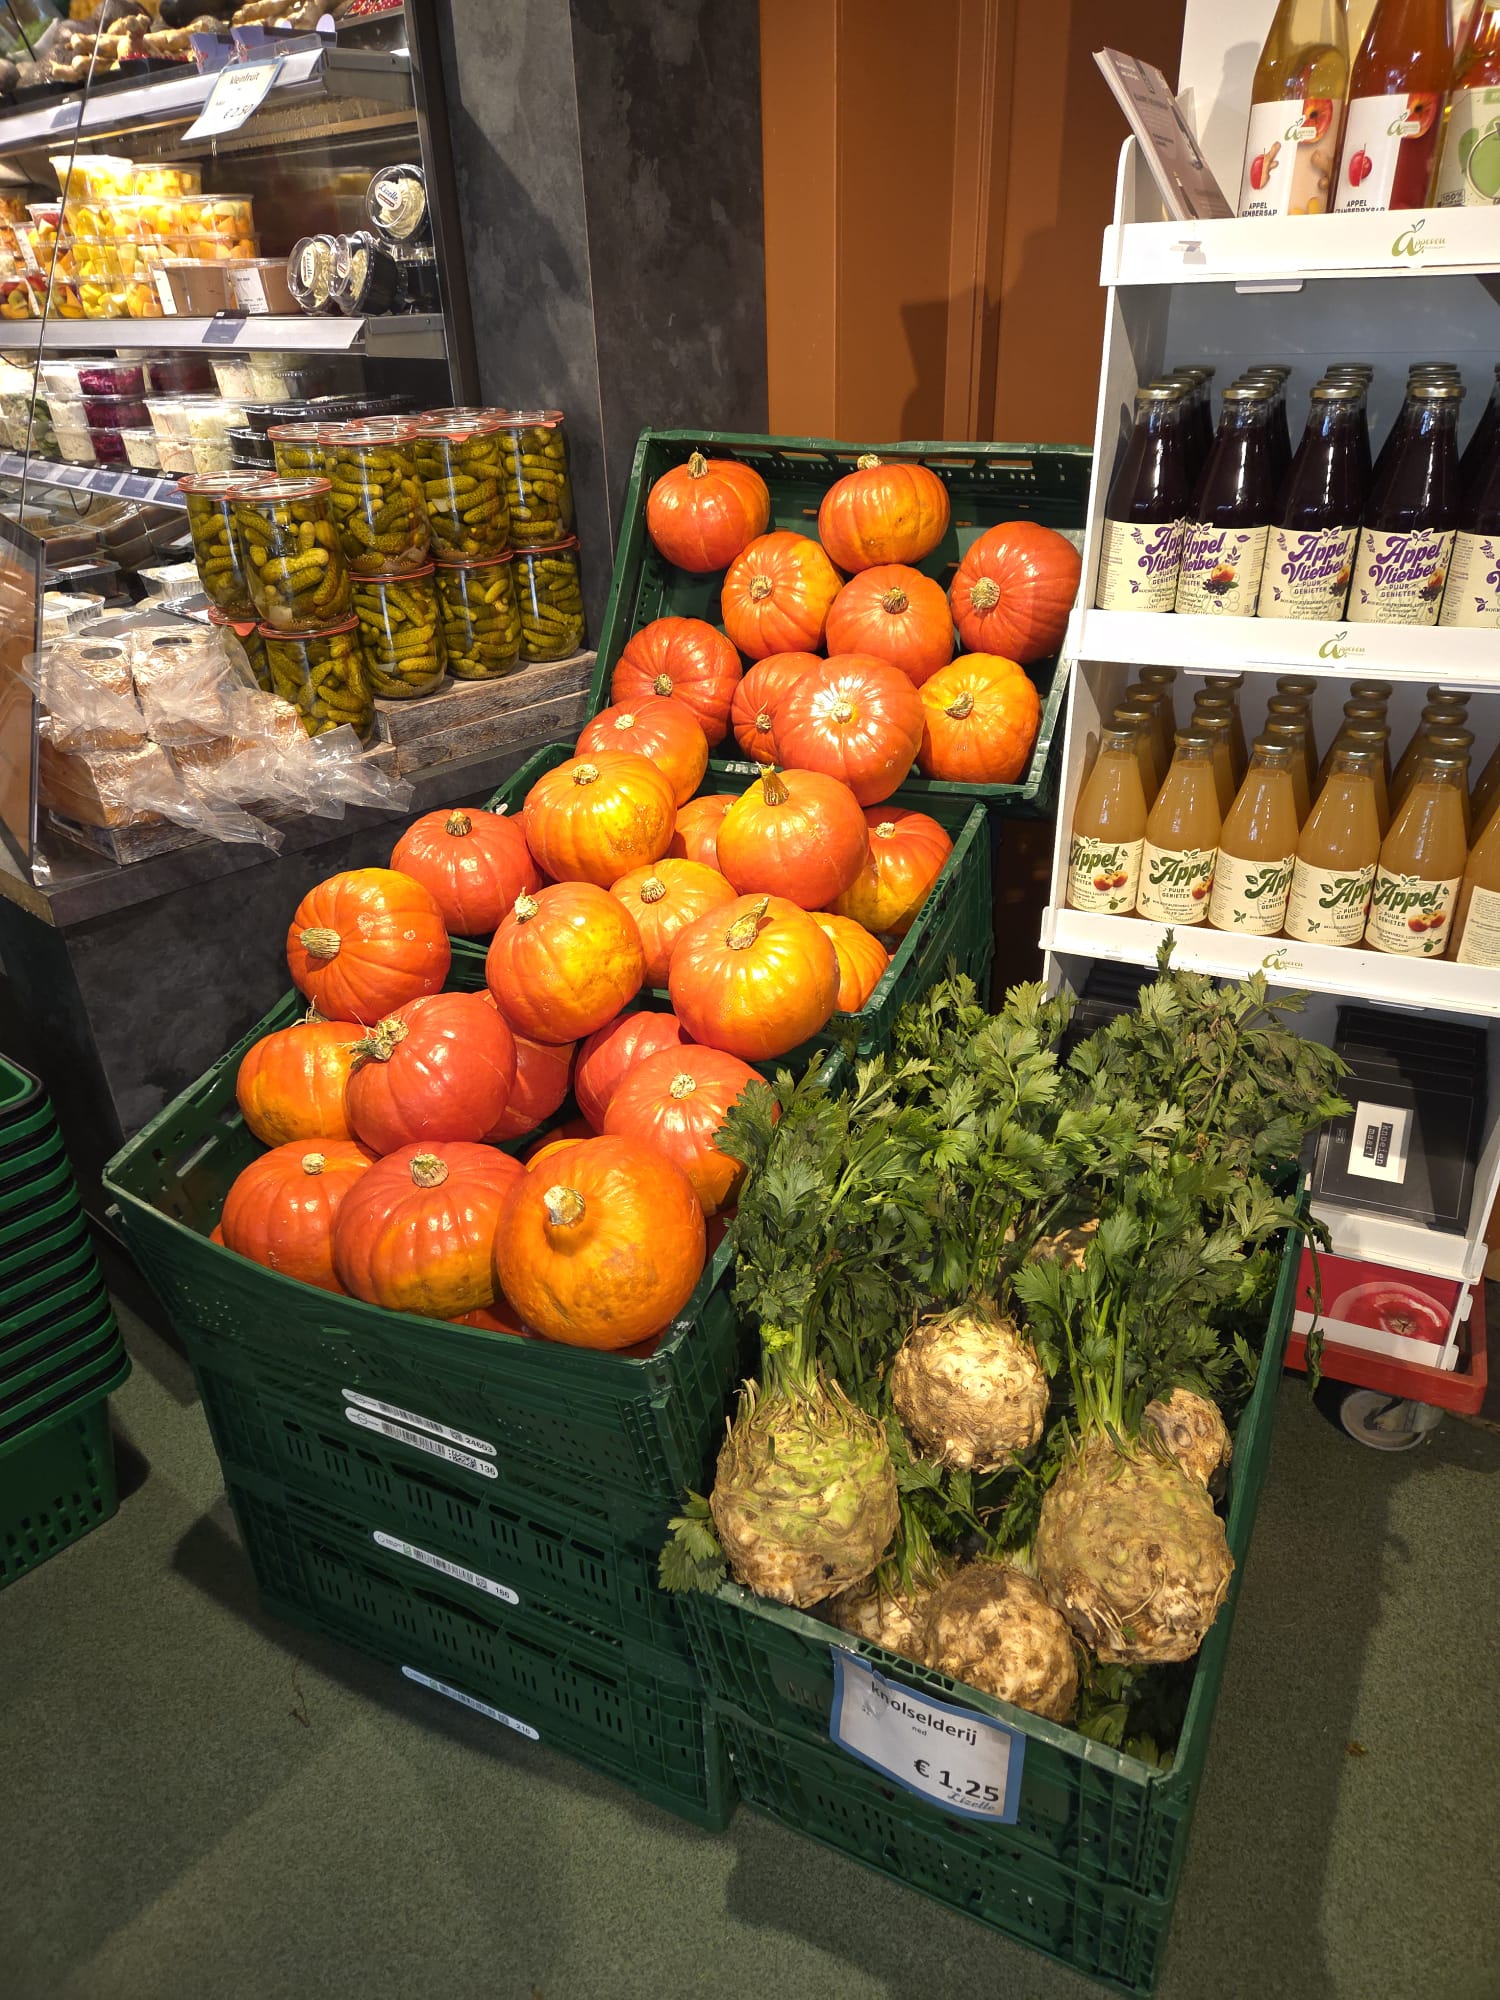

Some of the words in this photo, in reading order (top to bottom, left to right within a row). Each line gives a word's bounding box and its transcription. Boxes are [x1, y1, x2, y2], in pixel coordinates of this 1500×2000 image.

[1347, 199, 1367, 207] APPEL
[1288, 532, 1352, 567] Appel
[1375, 535, 1446, 570] Appel
[1281, 559, 1344, 584] Vlierbes
[1368, 562, 1437, 587] Vlierbes
[1149, 850, 1215, 887] Appel
[1373, 877, 1442, 914] Appel
[1383, 911, 1400, 920] PUUR
[871, 1680, 978, 1746] knolselderij
[913, 1758, 931, 1778] €
[939, 1769, 1000, 1803] 1.25
